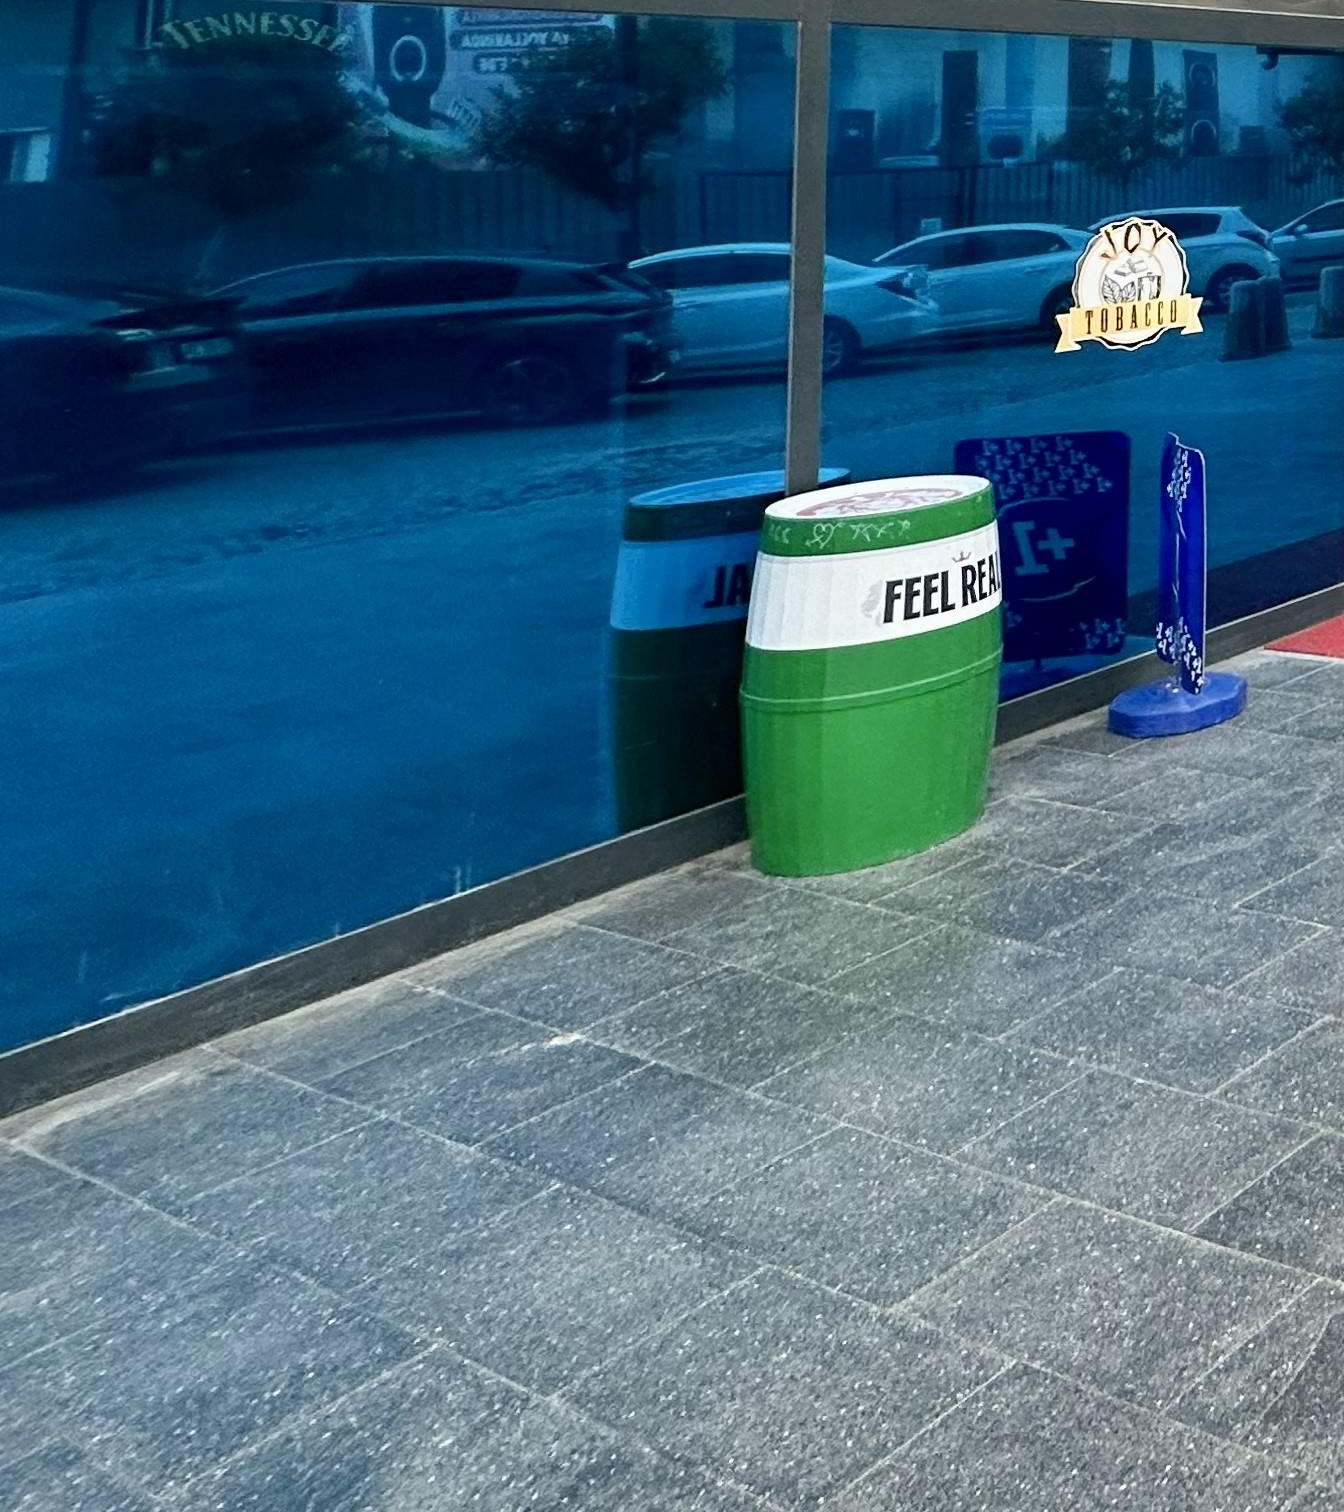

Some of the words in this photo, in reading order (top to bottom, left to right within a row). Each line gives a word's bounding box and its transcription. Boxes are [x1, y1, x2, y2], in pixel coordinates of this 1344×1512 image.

[1100, 222, 1168, 258] JOY
[1085, 299, 1177, 335] TOBACCO
[883, 570, 956, 625] FEEL
